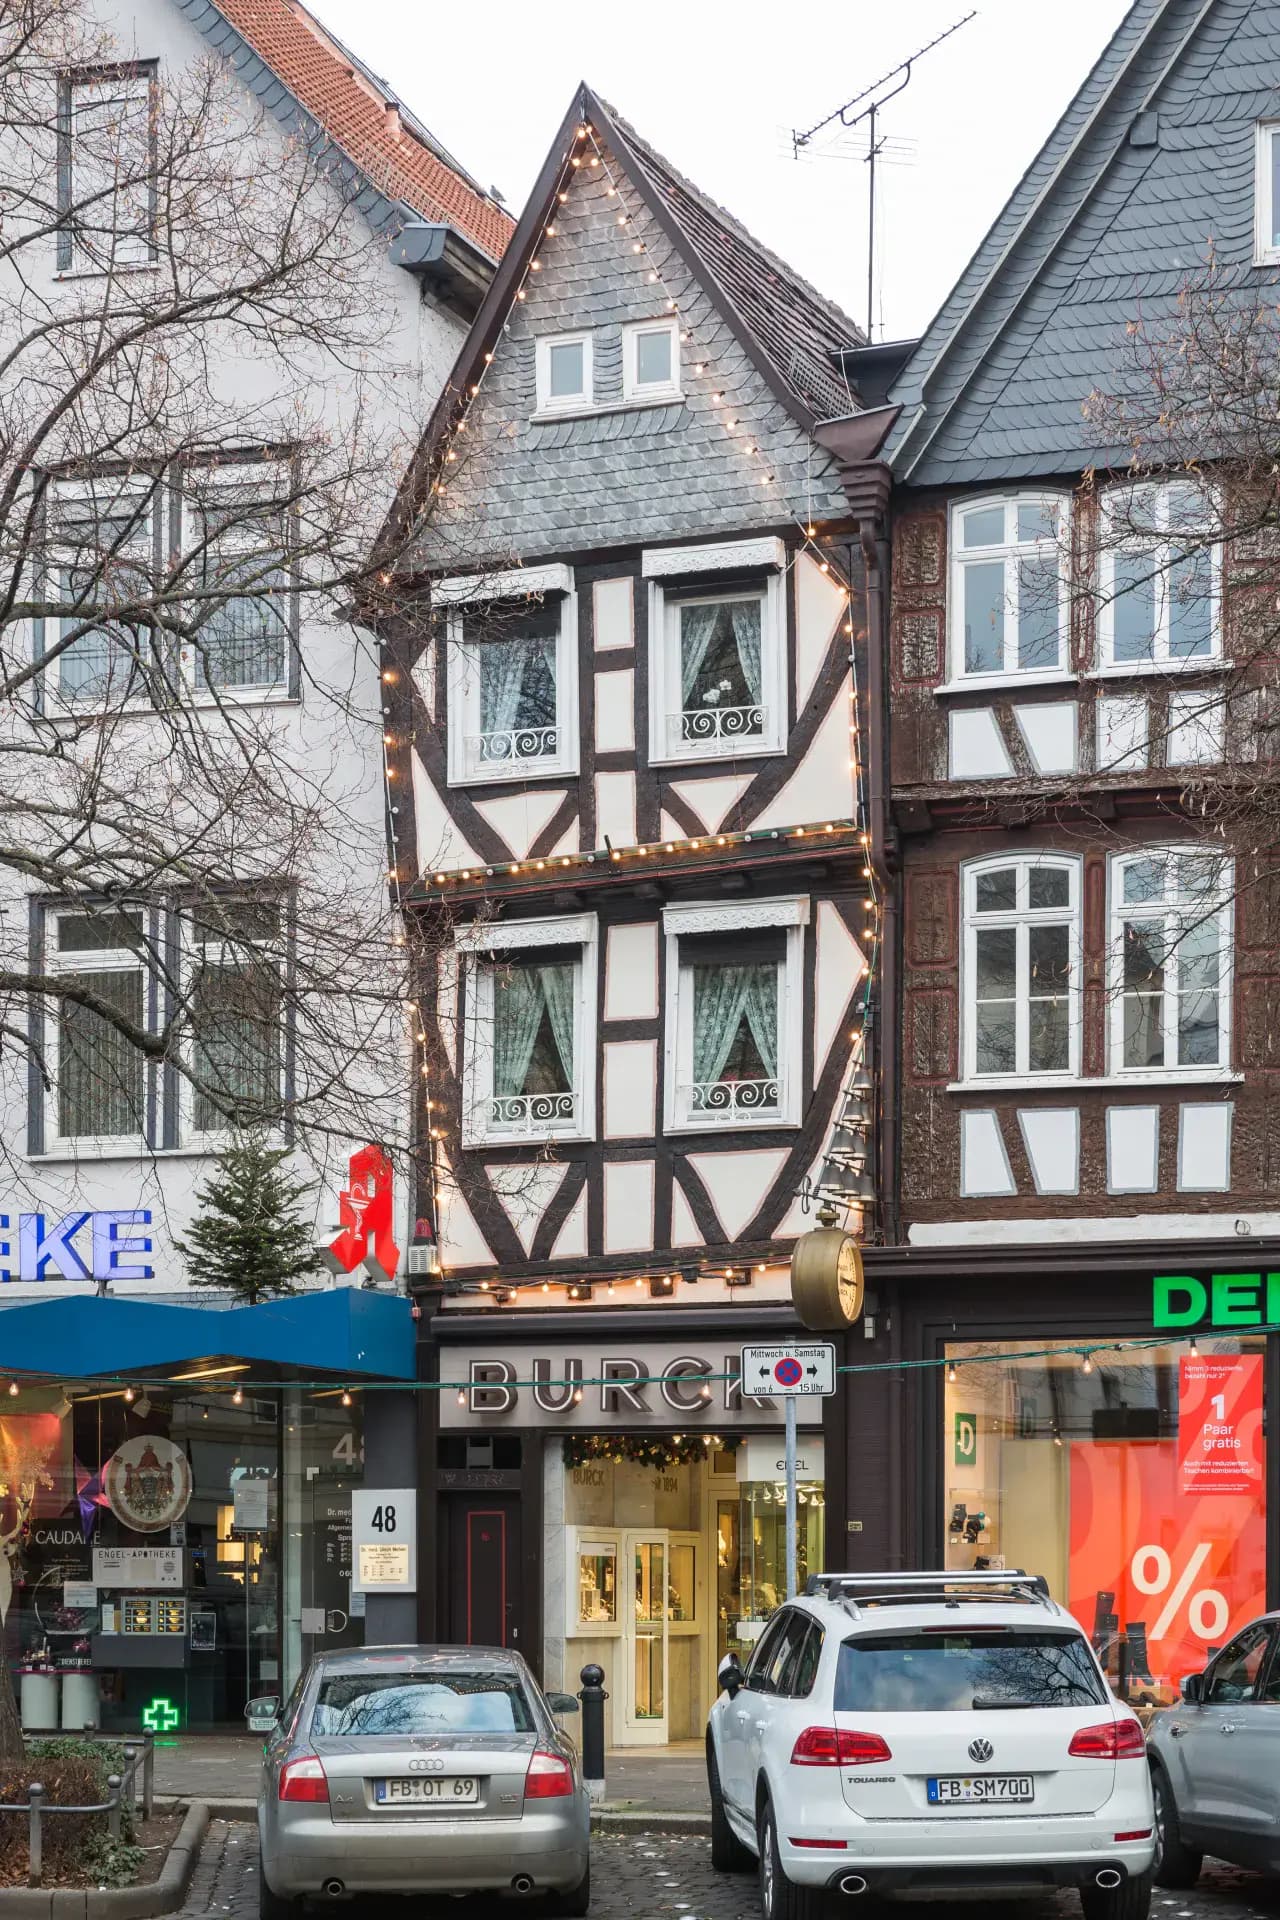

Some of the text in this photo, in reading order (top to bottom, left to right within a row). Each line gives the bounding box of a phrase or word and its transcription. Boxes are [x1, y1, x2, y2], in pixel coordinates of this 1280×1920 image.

[0, 1210, 153, 1282] KE
[750, 1349, 783, 1358] Mittwoch
[795, 1348, 825, 1358] Samstag
[768, 1385, 773, 1393] 6
[800, 1383, 809, 1392] 15
[811, 1384, 824, 1392] Uhr
[1211, 1394, 1225, 1420] 1
[1203, 1424, 1233, 1435] Paar
[1203, 1437, 1241, 1450] gratis
[776, 1460, 809, 1470] EEL
[573, 1469, 605, 1486] BURCK
[371, 1505, 396, 1533] 48
[35, 1530, 101, 1545] CAUDAE
[98, 1550, 176, 1559] ENGEL-APOTHEKE
[390, 1781, 411, 1797] FB
[423, 1780, 444, 1796] OT
[453, 1780, 473, 1796] 69
[940, 1781, 961, 1797] FB
